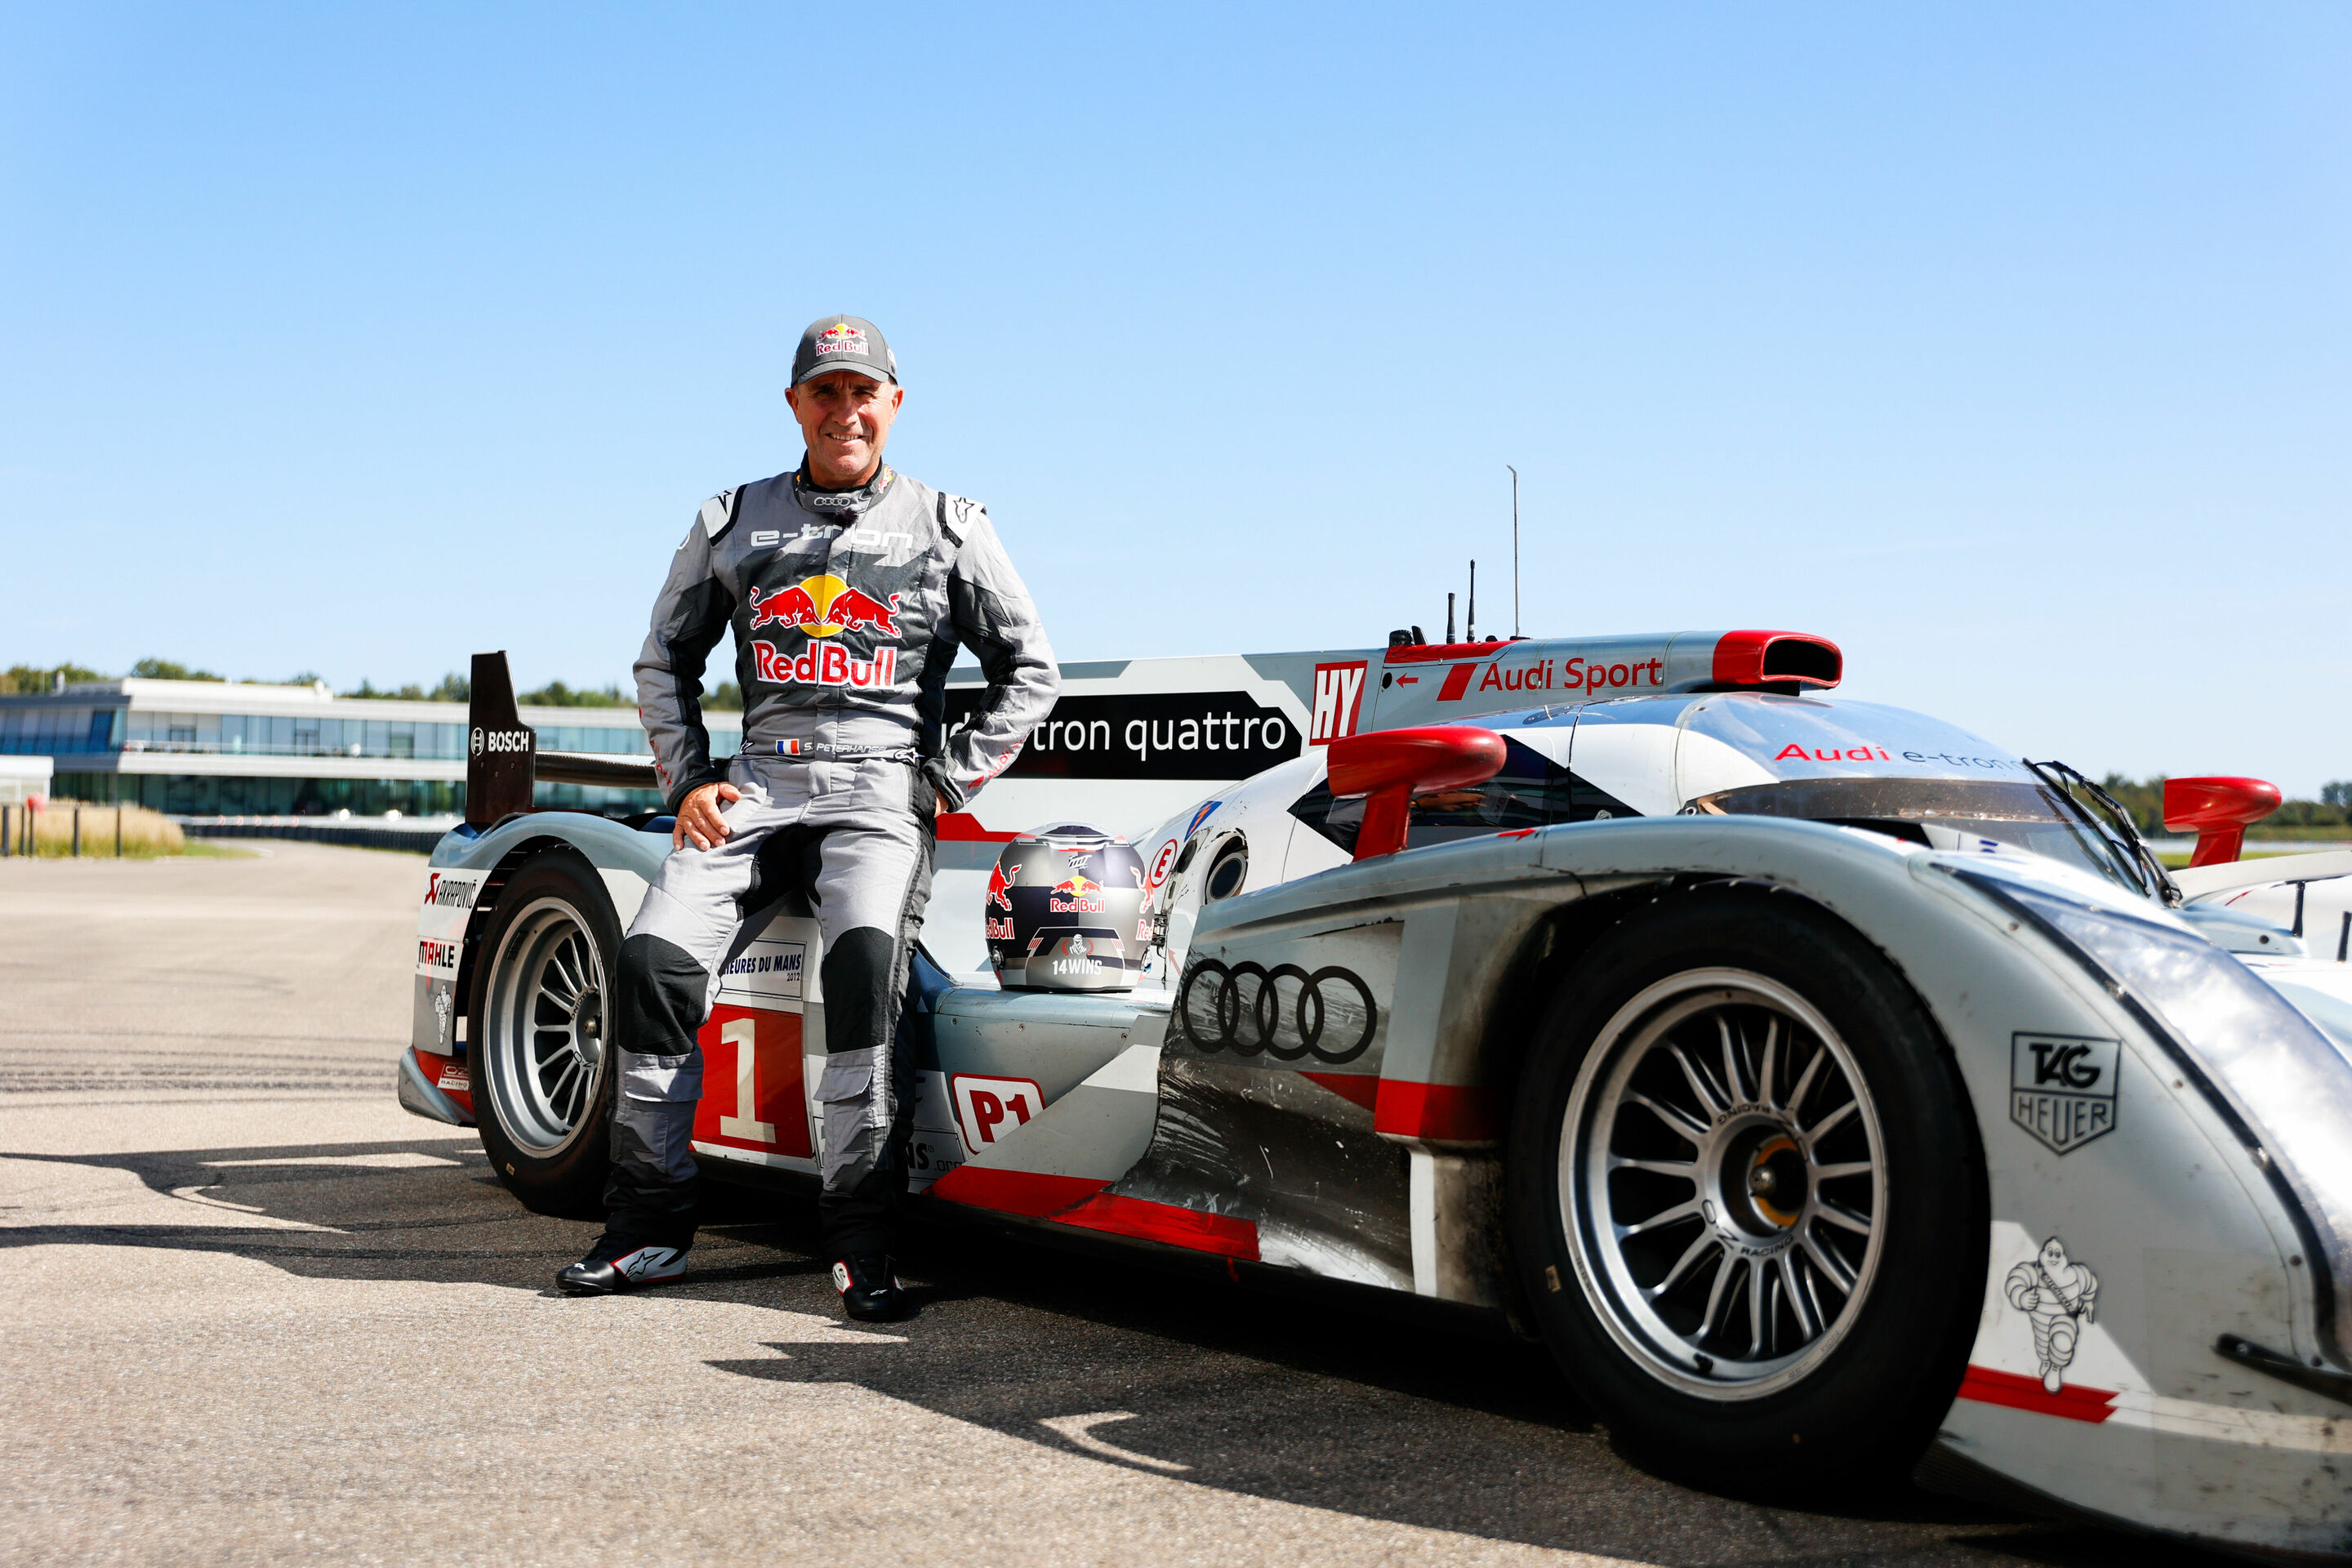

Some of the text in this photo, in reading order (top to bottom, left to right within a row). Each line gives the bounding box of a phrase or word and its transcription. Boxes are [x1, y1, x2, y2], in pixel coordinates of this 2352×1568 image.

[816, 339, 869, 356] Red Bull
[751, 523, 914, 550] e-tron
[751, 639, 897, 689] Red Bull
[1479, 657, 1663, 697] Audi Sport
[1312, 667, 1365, 740] HY
[488, 730, 530, 753] BOSCH
[803, 742, 813, 751] S.
[1033, 717, 1110, 751] tron
[1125, 711, 1285, 762] quattro
[1773, 743, 1891, 761] Audi
[1902, 751, 2012, 772] e-tron
[1154, 848, 1172, 879] E
[1050, 898, 1105, 913] Red Bull
[417, 940, 456, 969] MAHLE
[758, 955, 773, 973] DU
[773, 953, 802, 972] MANS
[786, 972, 801, 982] 2012
[2028, 1041, 2101, 1089] TAG
[719, 1018, 777, 1144] 1
[969, 1089, 1031, 1143] P1
[2018, 1096, 2108, 1146] HEUER
[1740, 1233, 1794, 1257] RACING
